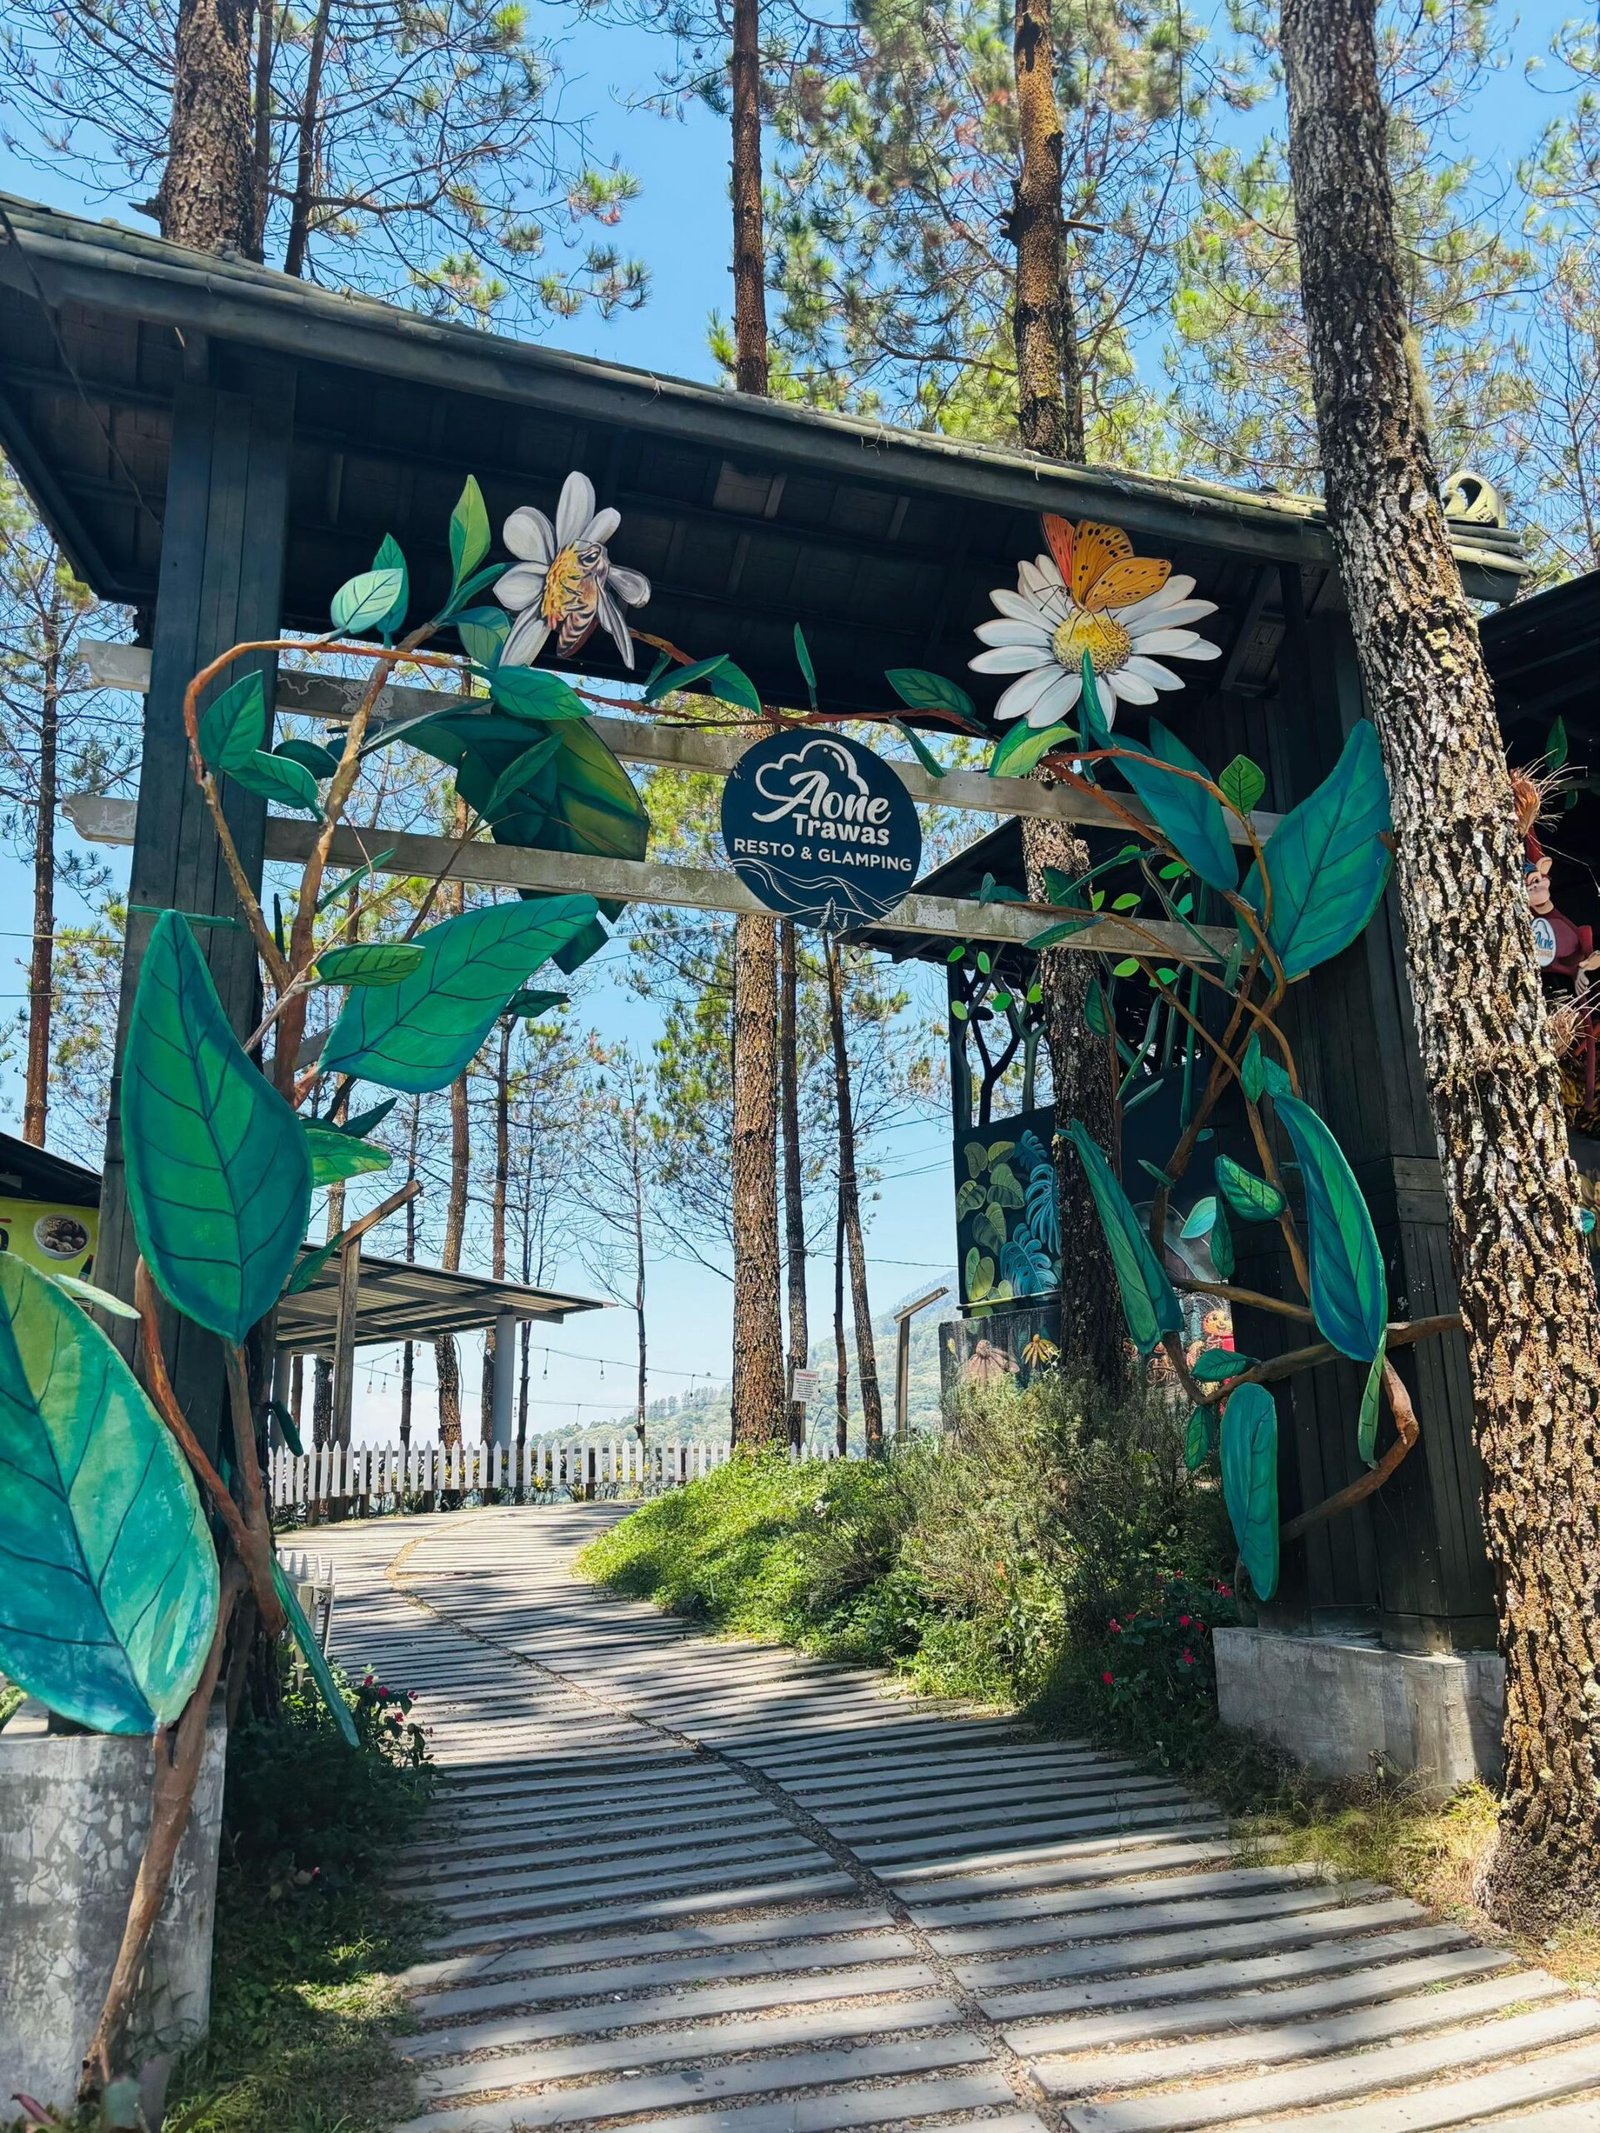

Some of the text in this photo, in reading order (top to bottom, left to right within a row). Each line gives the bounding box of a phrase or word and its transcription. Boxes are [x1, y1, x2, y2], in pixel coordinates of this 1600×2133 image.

[752, 770, 892, 825] Aone
[792, 812, 890, 846] Trawas
[734, 838, 912, 872] RESTO & GLAMPING
